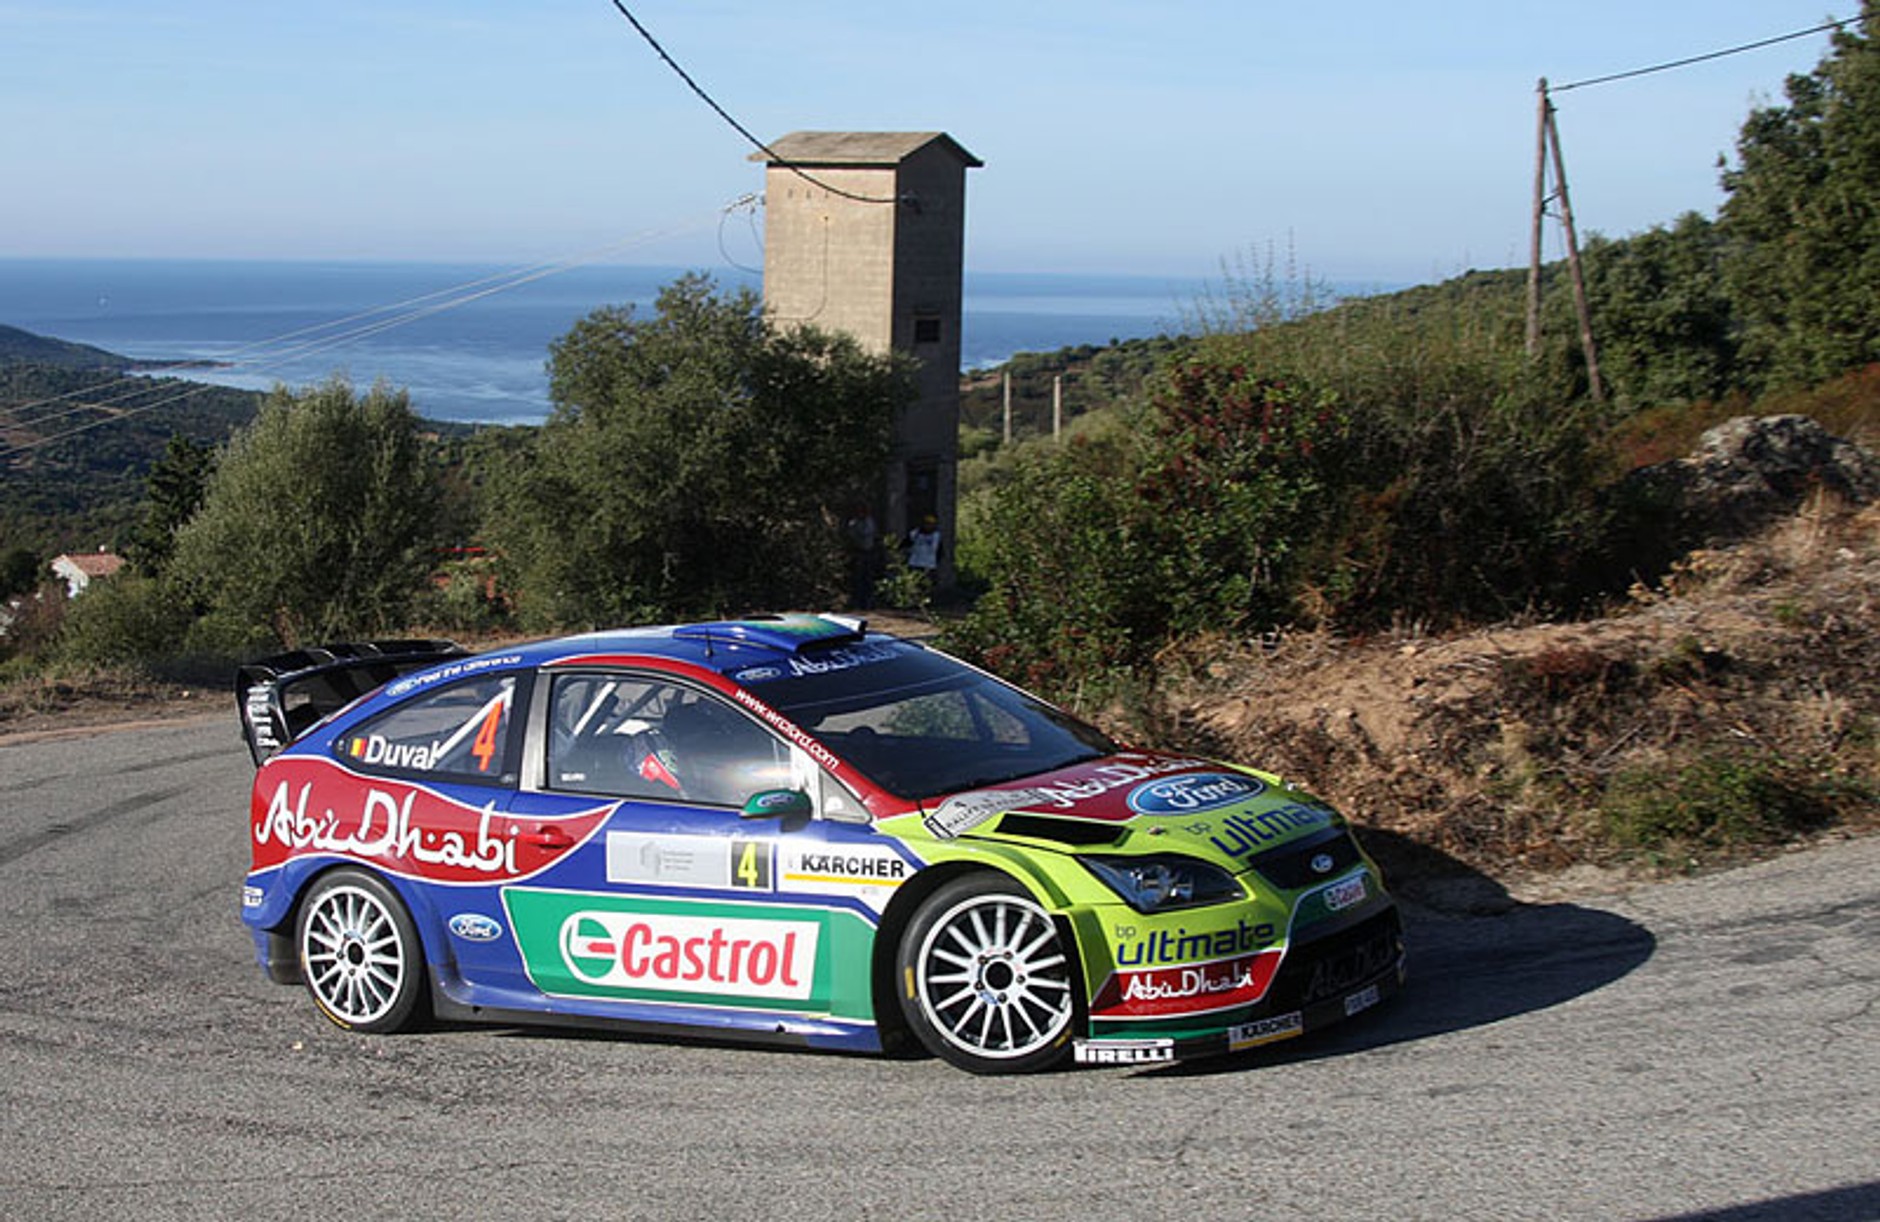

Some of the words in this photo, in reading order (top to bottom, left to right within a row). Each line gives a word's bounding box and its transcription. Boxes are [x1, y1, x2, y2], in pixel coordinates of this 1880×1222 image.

[472, 701, 504, 772] 4
[1150, 778, 1250, 808] Ford
[256, 781, 352, 849] Abu
[354, 789, 520, 875] Dhabi
[737, 842, 758, 888] 4
[801, 854, 904, 878] KÄRCHER
[1116, 923, 1137, 940] bp
[1117, 920, 1276, 966] ultimate
[621, 923, 798, 987] Castrol
[1122, 972, 1182, 1001] Abu
[1177, 965, 1255, 998] Dhabi
[1072, 1038, 1174, 1064] PIRELLI
